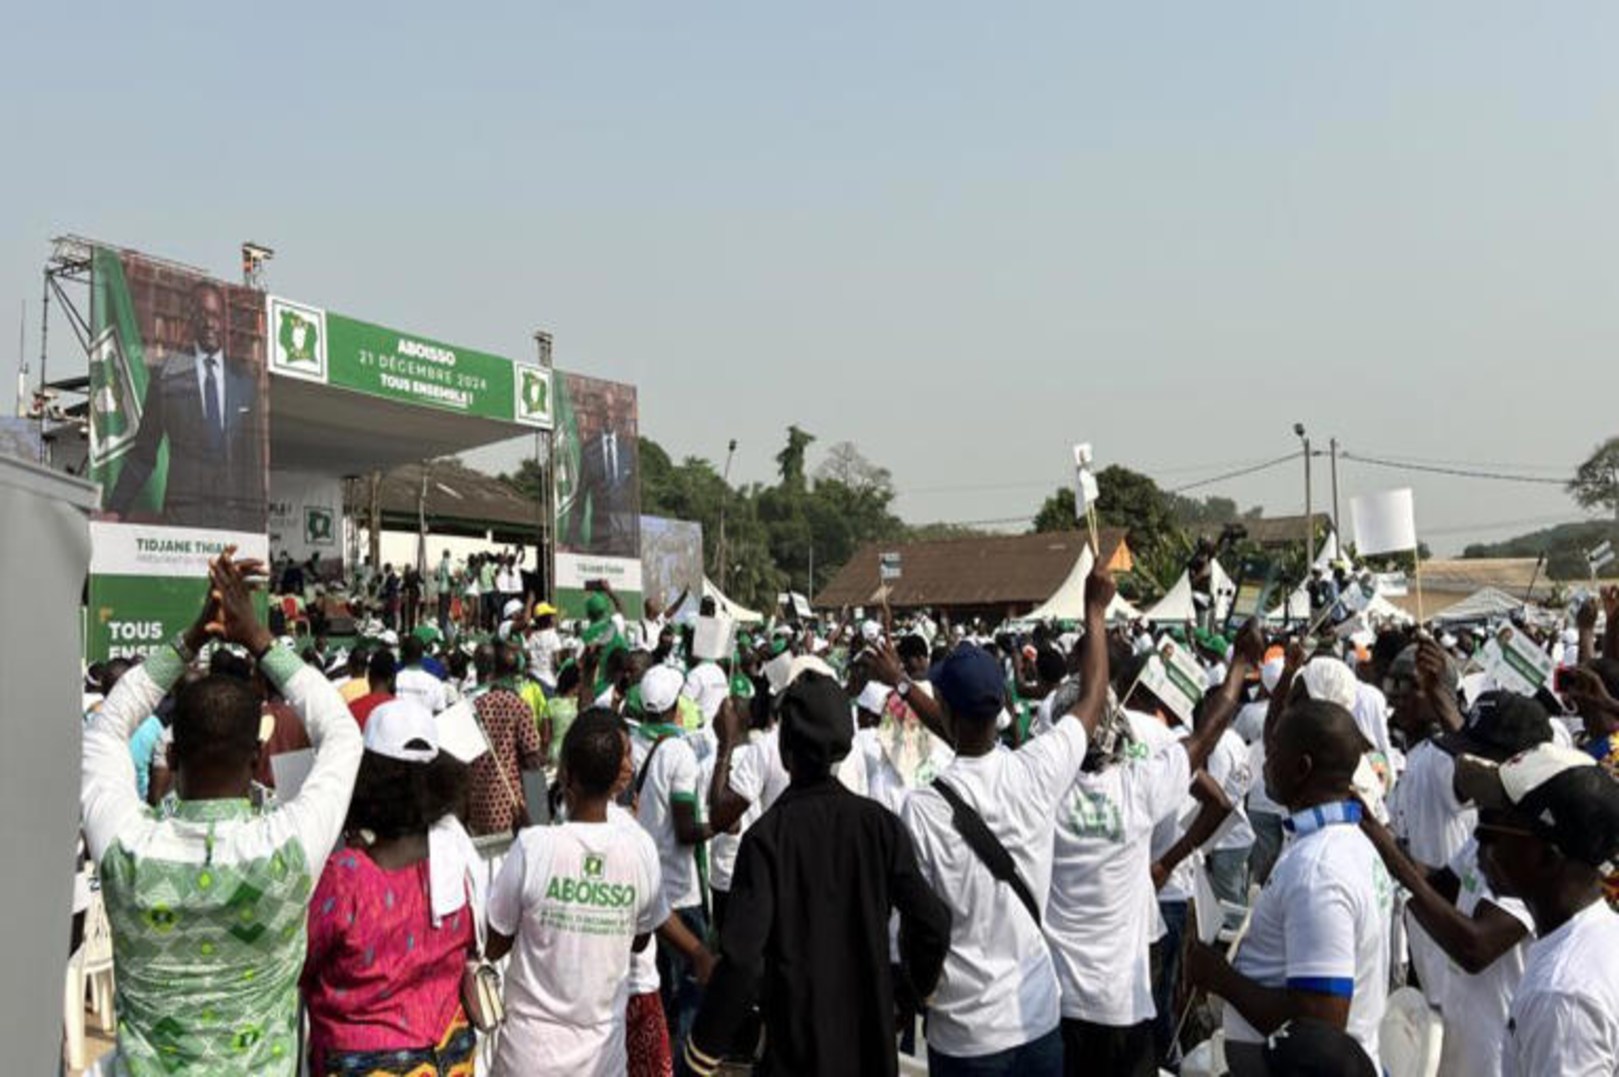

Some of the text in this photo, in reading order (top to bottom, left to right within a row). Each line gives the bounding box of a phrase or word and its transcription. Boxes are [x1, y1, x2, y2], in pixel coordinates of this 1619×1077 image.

[360, 350, 374, 366] 21
[398, 339, 456, 366] ABOISSO
[380, 373, 410, 392] TOUS
[135, 538, 192, 554] TIDJANE
[108, 622, 163, 640] TOUS
[546, 876, 636, 908] ABOISSO
